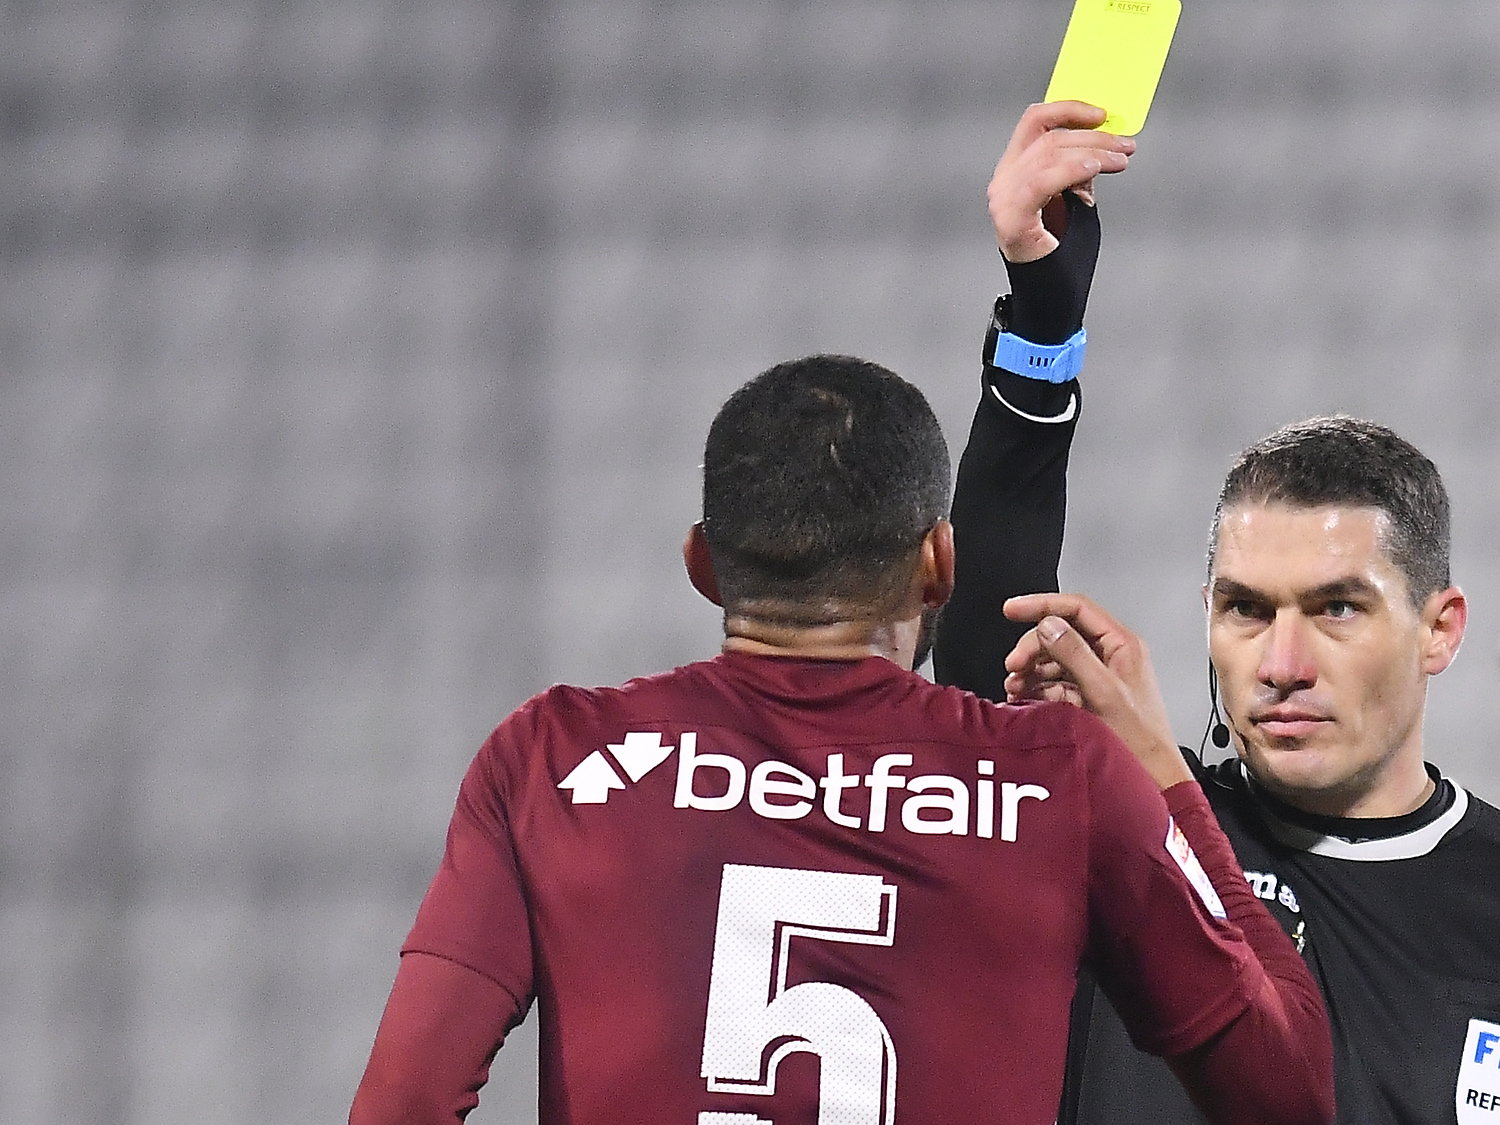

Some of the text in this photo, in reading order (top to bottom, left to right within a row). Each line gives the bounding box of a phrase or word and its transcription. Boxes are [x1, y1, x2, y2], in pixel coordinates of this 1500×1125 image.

[1117, 3, 1150, 12] RESPECT
[673, 732, 1050, 842] betfair
[1243, 871, 1300, 913] ma
